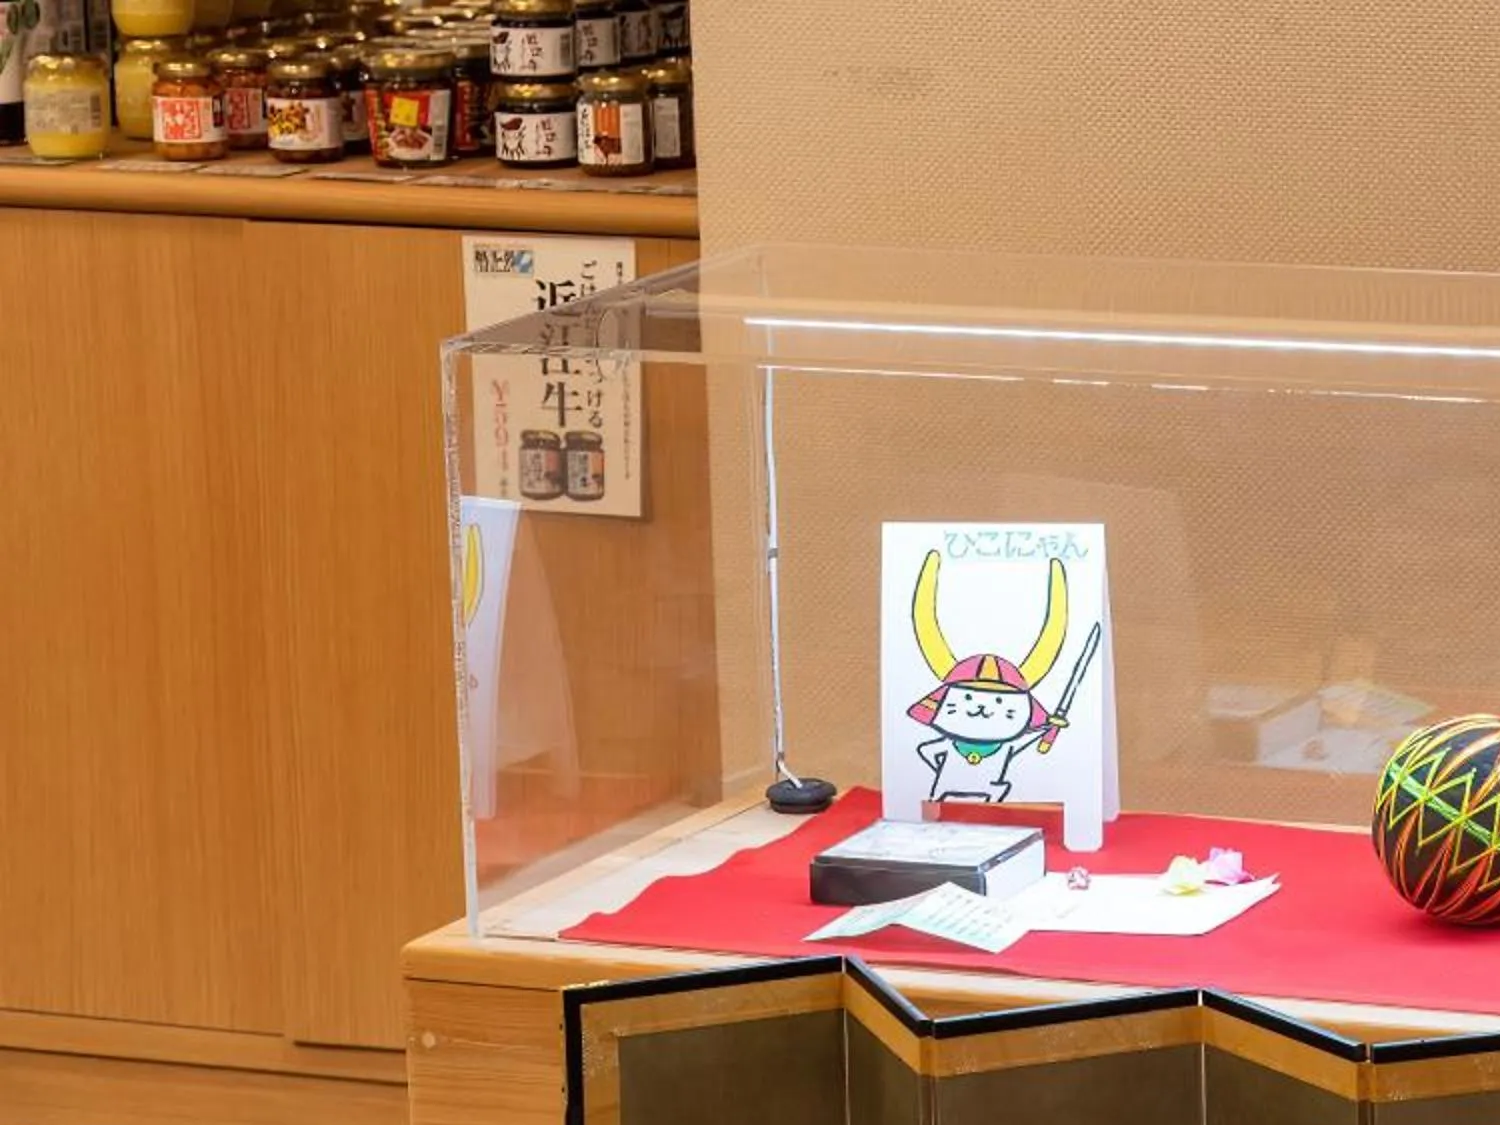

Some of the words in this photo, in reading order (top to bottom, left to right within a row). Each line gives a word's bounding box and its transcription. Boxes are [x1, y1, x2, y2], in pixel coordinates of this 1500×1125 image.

[944, 529, 1089, 561] ひこにゃん
